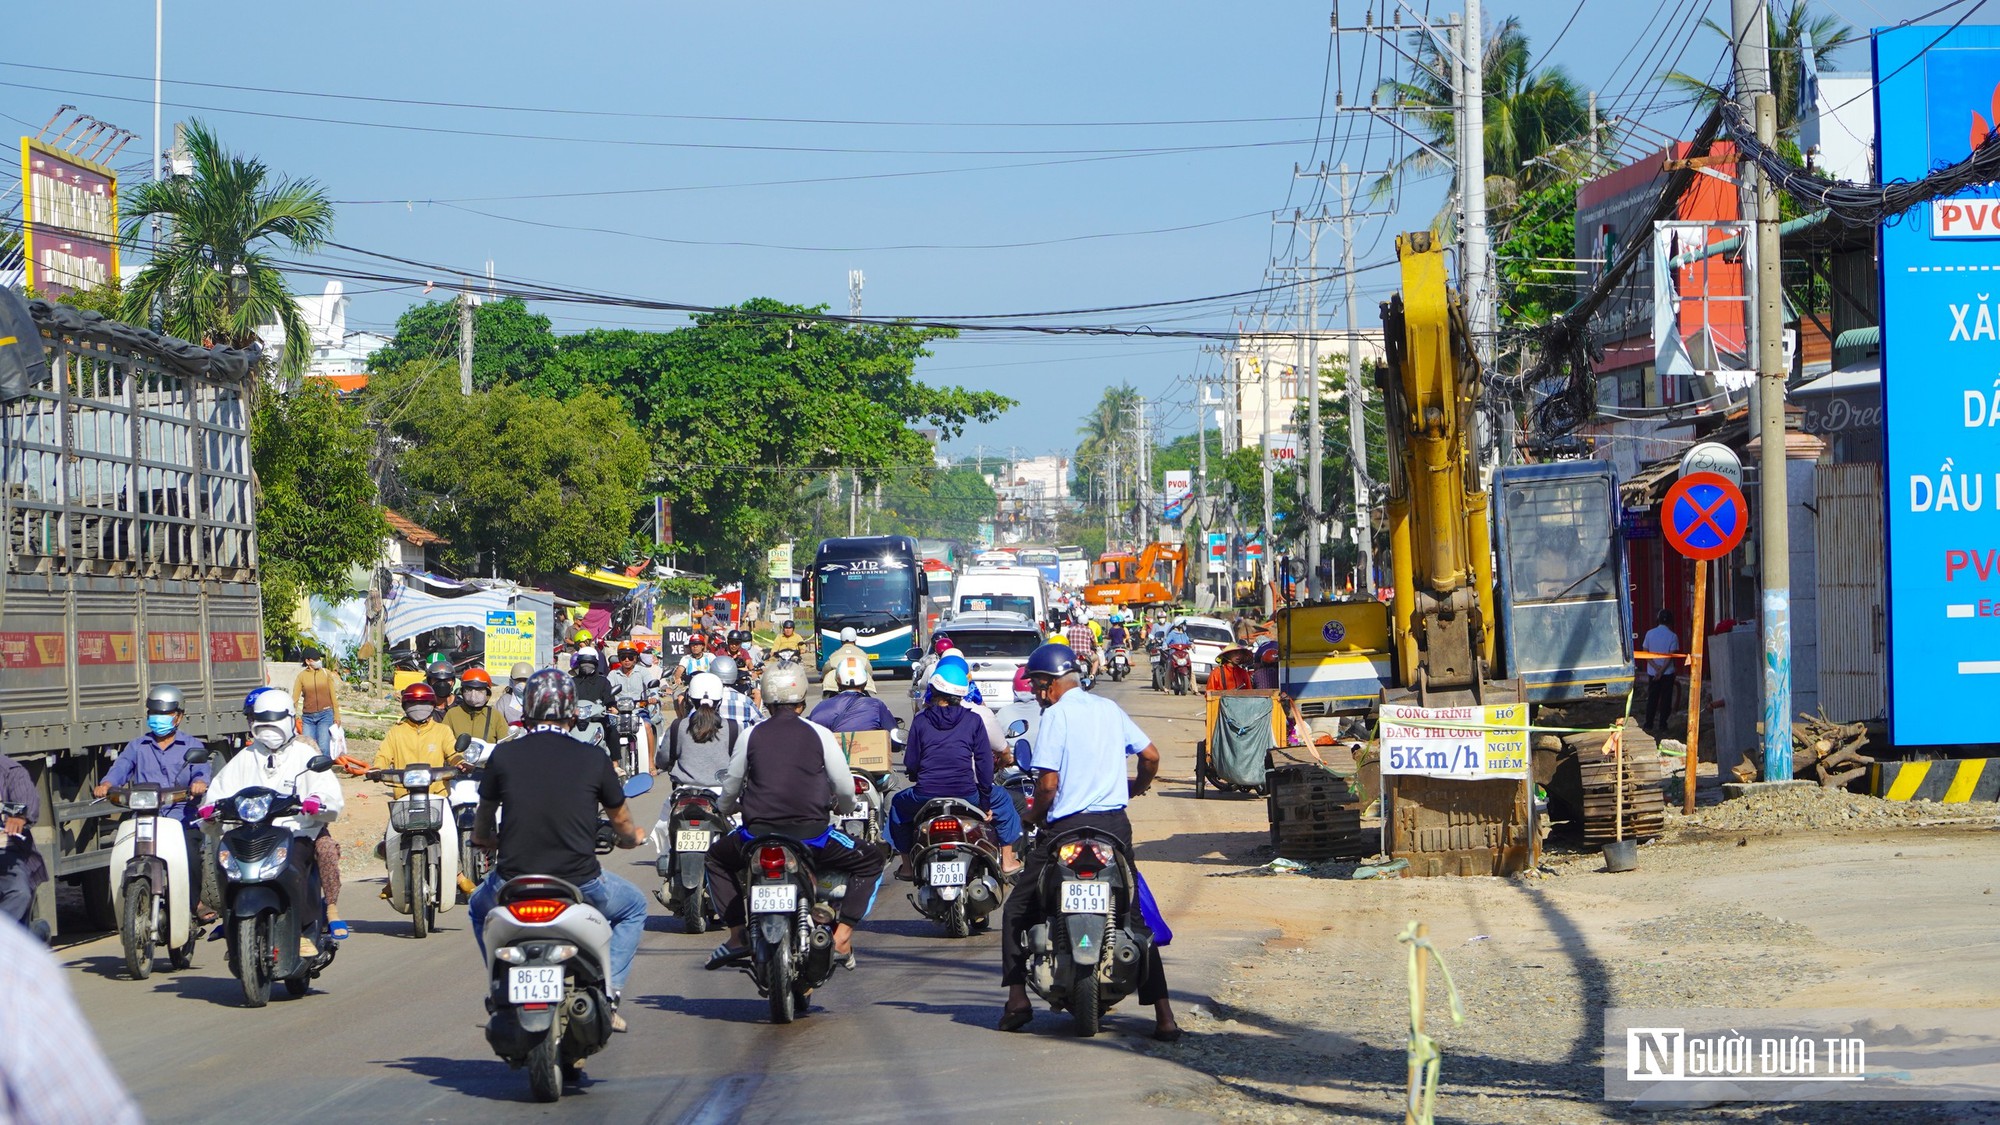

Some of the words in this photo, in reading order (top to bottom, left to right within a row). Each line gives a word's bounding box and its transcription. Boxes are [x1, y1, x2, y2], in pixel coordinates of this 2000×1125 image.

[1948, 292, 2000, 341] XĂ
[1270, 447, 1295, 459] VOIL
[1695, 452, 1737, 475] Dream
[1168, 480, 1188, 488] PVOIL
[1910, 457, 1982, 512] DẦU
[1945, 549, 2000, 582] PV
[671, 644, 684, 655] XE
[1396, 706, 1429, 719] CÔNG
[1434, 706, 1472, 719] TRÌNH
[1424, 727, 1445, 738] THI
[1488, 742, 1522, 752] NGUY
[1390, 744, 1480, 773] 5Km/h
[681, 831, 705, 841] 86-C1
[677, 841, 708, 850] 923.77
[936, 863, 960, 874] 86-C1
[933, 874, 964, 884] 270.80
[758, 887, 789, 898] 86-C1
[1069, 884, 1101, 895] 86-C1
[753, 899, 794, 910] 629.69
[1065, 897, 1105, 911] 491.91
[518, 969, 554, 983] 86-C2
[513, 985, 559, 999] 114.91
